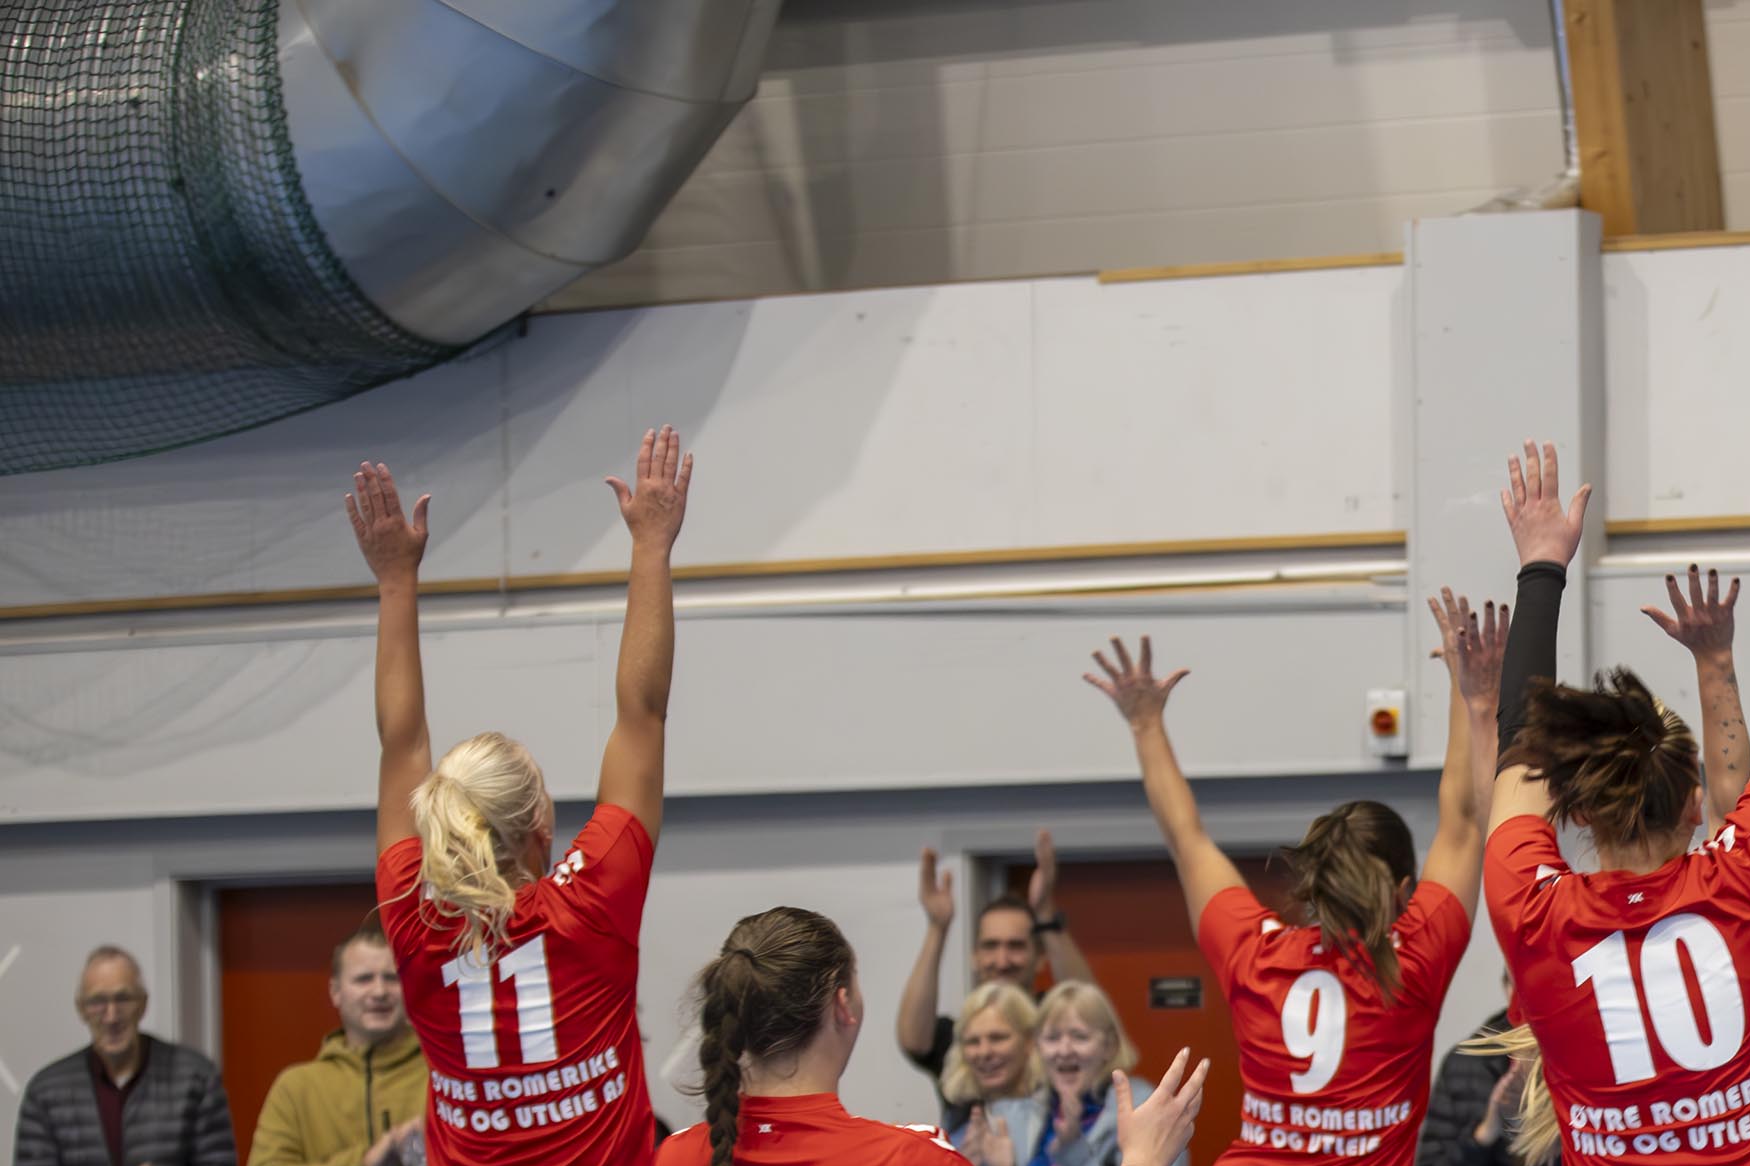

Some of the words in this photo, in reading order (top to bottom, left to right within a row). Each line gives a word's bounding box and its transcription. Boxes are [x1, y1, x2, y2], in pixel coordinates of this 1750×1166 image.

[441, 933, 559, 1069] 11
[1571, 912, 1745, 1085] 10
[1281, 969, 1346, 1094] 9
[471, 1108, 510, 1132] OG
[515, 1089, 598, 1129] UTLEIE
[602, 1072, 626, 1104] AS
[483, 1046, 619, 1102] ROMERIKE
[1270, 1127, 1304, 1150] OG
[1569, 1104, 1642, 1132] ØVRE
[1633, 1130, 1681, 1154] OG
